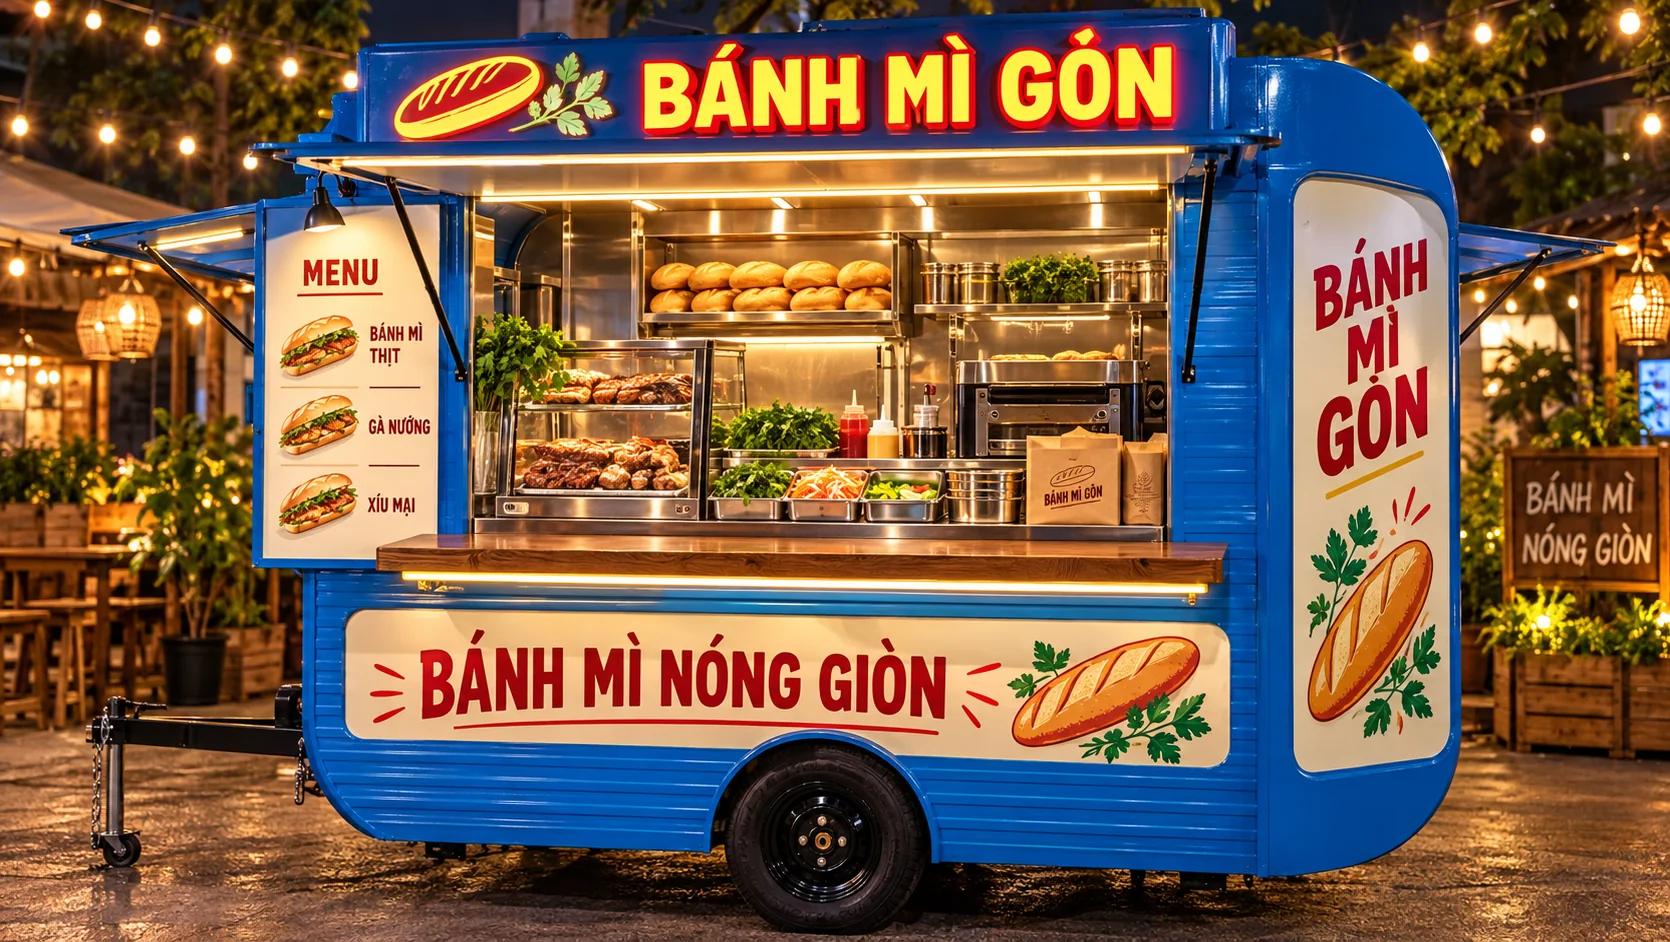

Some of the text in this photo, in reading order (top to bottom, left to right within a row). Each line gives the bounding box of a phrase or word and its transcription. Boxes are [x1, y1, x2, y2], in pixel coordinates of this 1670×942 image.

[642, 41, 863, 132] BÁNH
[886, 33, 975, 129] MÌ
[303, 259, 378, 286] MENU
[1314, 238, 1427, 331] BÁNH
[370, 322, 423, 341] BÁNH MÌ
[370, 348, 401, 367] THỊT
[368, 415, 430, 434] GÀ NƯỚNG
[368, 493, 415, 517] XÍU MẠI
[1044, 490, 1068, 506] BÁNH
[1526, 470, 1635, 515] BÁNH MÌ
[1522, 522, 1653, 566] NÓNG GIÒN
[420, 629, 947, 720] BÁNH MÌ NÓNG GIÒN
